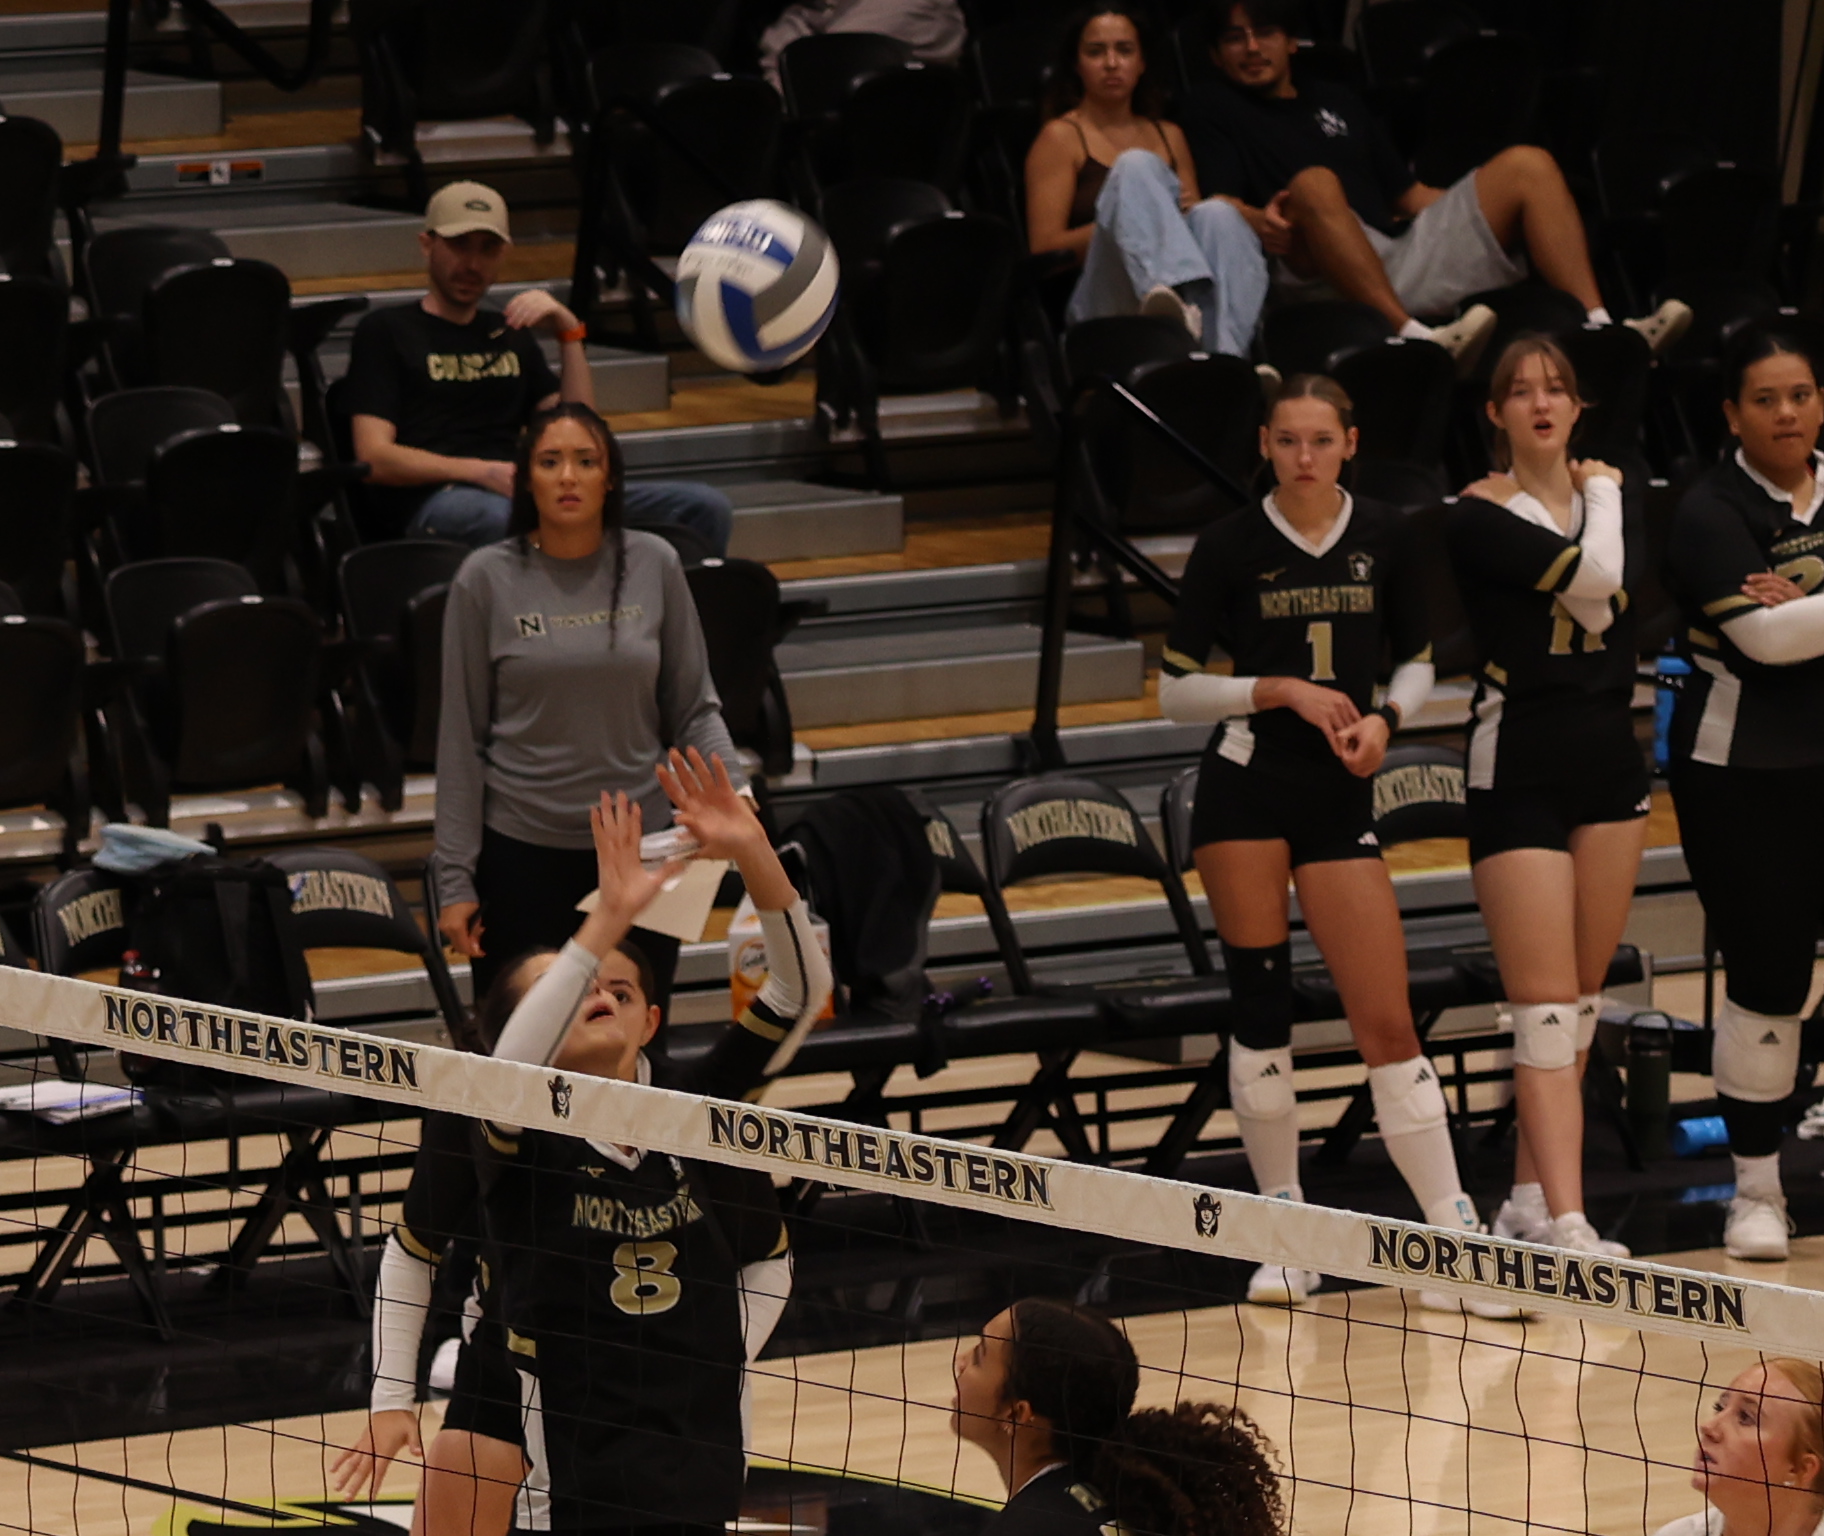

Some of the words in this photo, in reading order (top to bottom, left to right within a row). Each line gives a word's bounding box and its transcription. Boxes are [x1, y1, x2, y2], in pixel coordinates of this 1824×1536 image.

[515, 612, 547, 639] N
[1306, 622, 1336, 681] 1
[103, 991, 421, 1091] NORTHEASTERN
[706, 1100, 1056, 1210] NORTHEASTERN
[610, 1241, 682, 1315] 8
[1367, 1220, 1750, 1333] NORTHEASTERN
